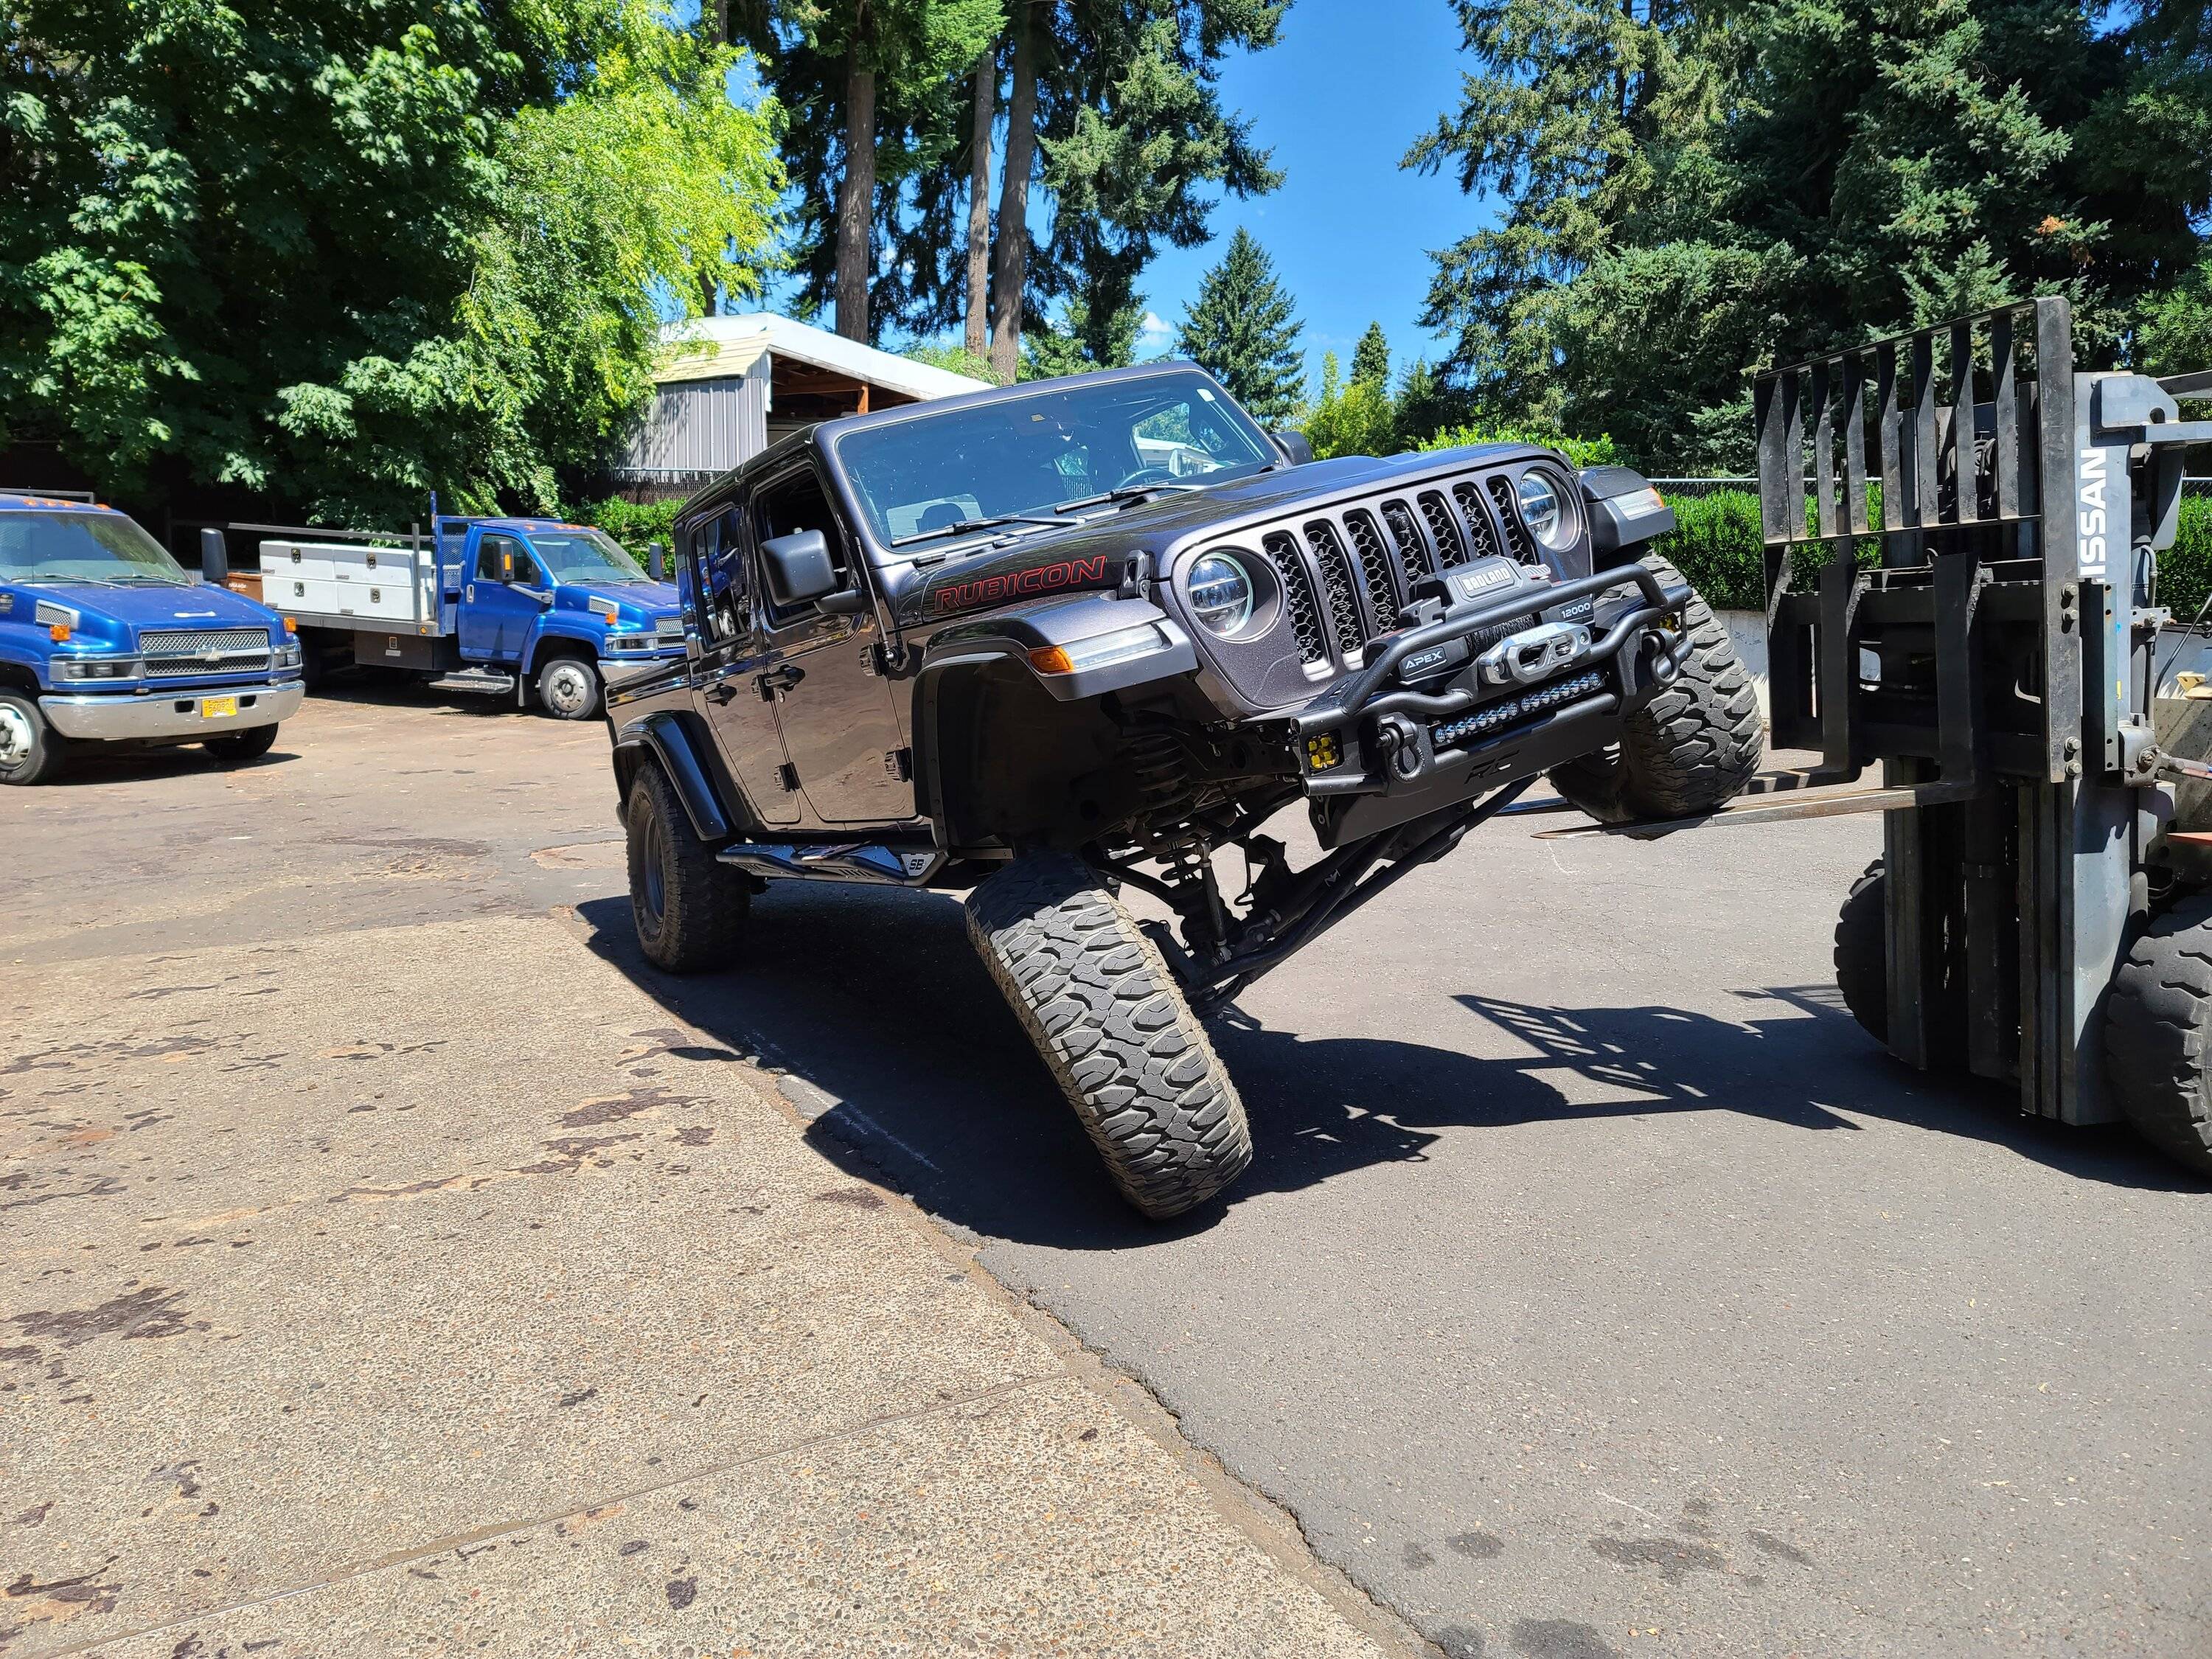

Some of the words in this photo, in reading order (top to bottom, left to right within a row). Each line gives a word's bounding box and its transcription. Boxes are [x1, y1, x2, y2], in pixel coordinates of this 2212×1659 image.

[2079, 448, 2107, 582] ISSAN
[934, 555, 1106, 612] RUBICON
[1462, 567, 1511, 591] BADLAND
[1561, 602, 1591, 619] 12000
[1405, 650, 1443, 669] APEX
